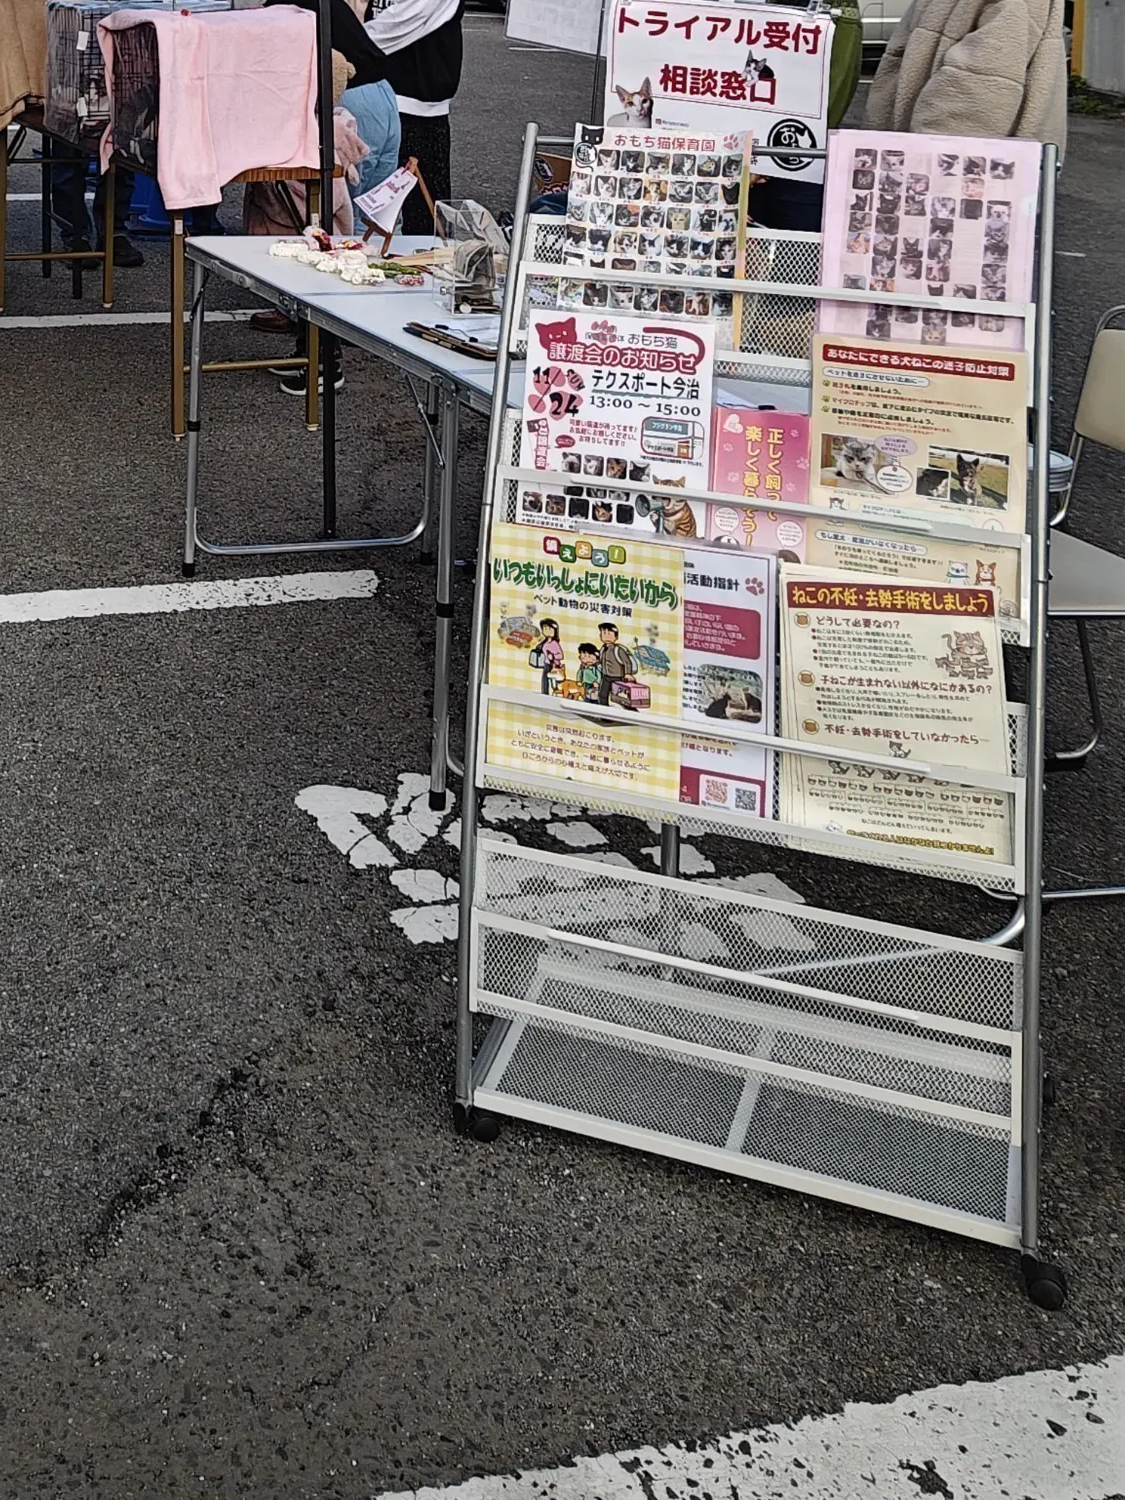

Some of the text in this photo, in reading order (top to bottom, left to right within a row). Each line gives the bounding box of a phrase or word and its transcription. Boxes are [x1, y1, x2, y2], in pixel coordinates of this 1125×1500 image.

[618, 7, 822, 55] トライアル受付
[659, 63, 777, 105] 相談窓口
[614, 133, 716, 152] おもち猫保育園
[627, 332, 678, 350] おもち猫
[548, 341, 698, 374] 譲渡会のお知らせ
[591, 368, 701, 400] テクスポート今治
[549, 391, 580, 418] 24
[589, 395, 633, 410] 13:00
[656, 404, 702, 418] 15:00
[493, 556, 678, 610] いつもいっしょにいたいから
[533, 593, 633, 618] ペット動物の災害対策
[791, 585, 990, 614] ねこの不妊・去勢手術をしましょう
[815, 616, 901, 629] どうして必要なの?
[820, 675, 993, 695] 子ねこが生まれない以外になにかあるの?
